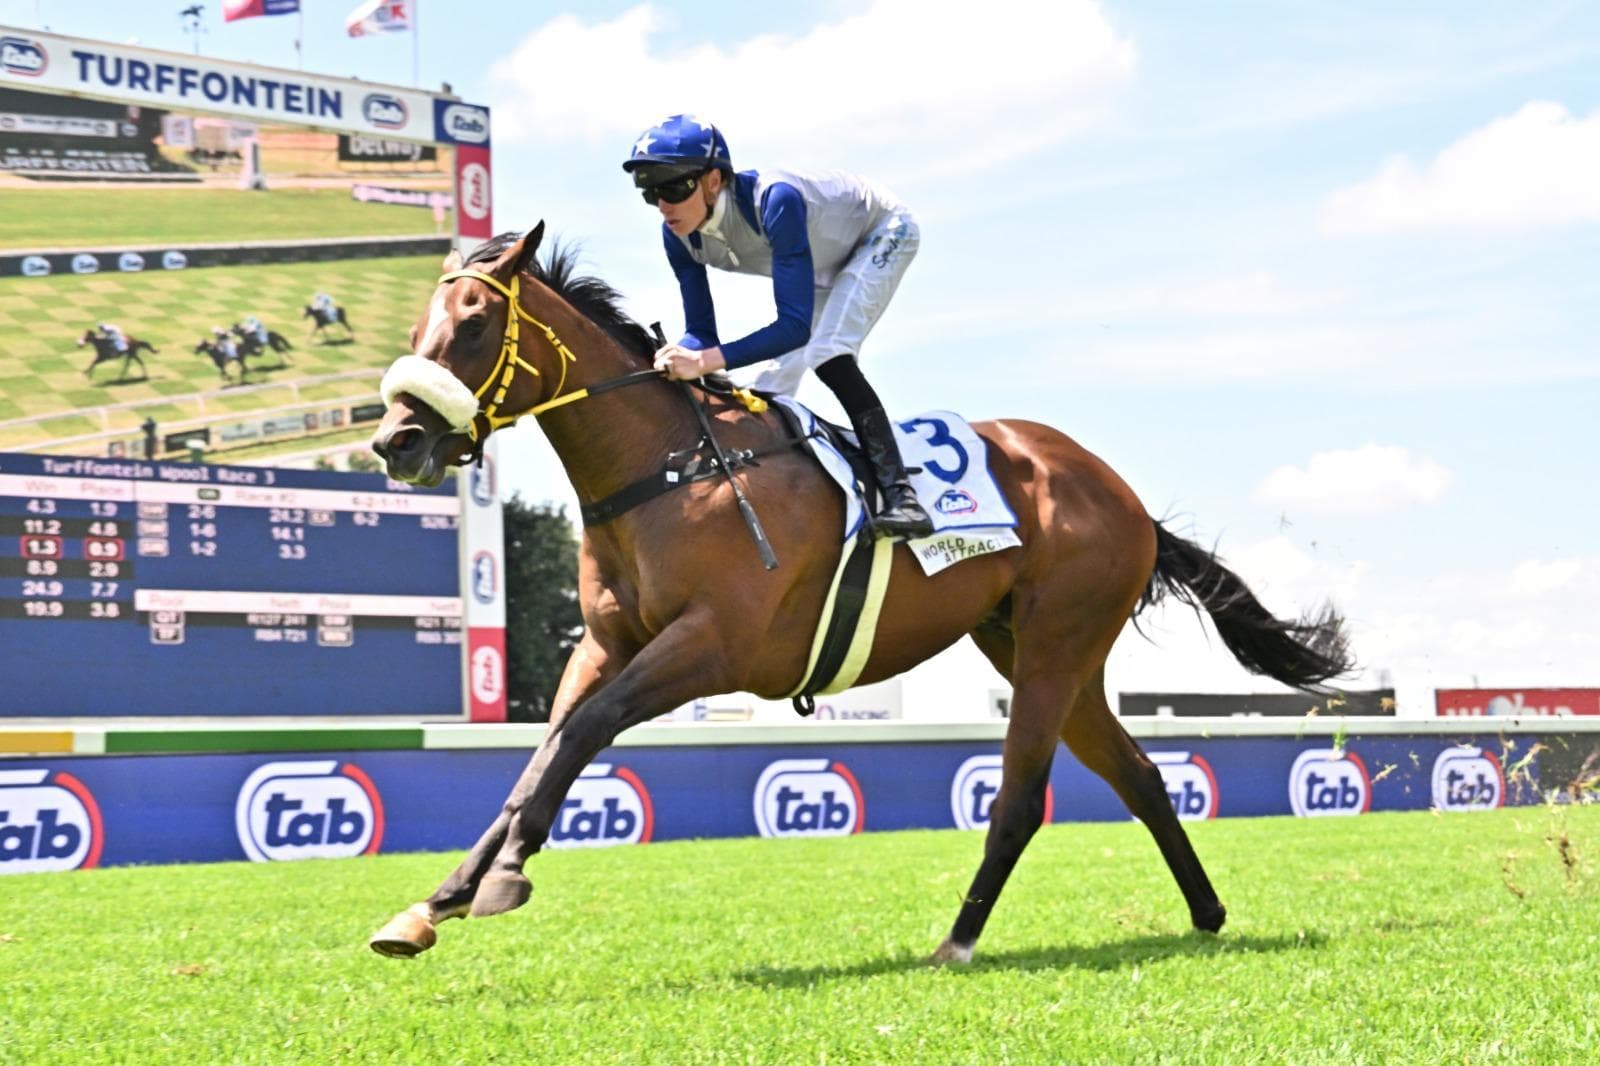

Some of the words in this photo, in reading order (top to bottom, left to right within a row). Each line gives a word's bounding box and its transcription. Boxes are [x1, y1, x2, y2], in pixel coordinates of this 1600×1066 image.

[72, 50, 343, 119] TURFFONTEIN
[900, 418, 969, 485] 3
[922, 537, 965, 560] WORLD
[776, 786, 850, 831] tab
[1306, 772, 1359, 810] tab
[1446, 770, 1494, 805] tab
[0, 809, 81, 861] ab
[265, 793, 365, 847] tab
